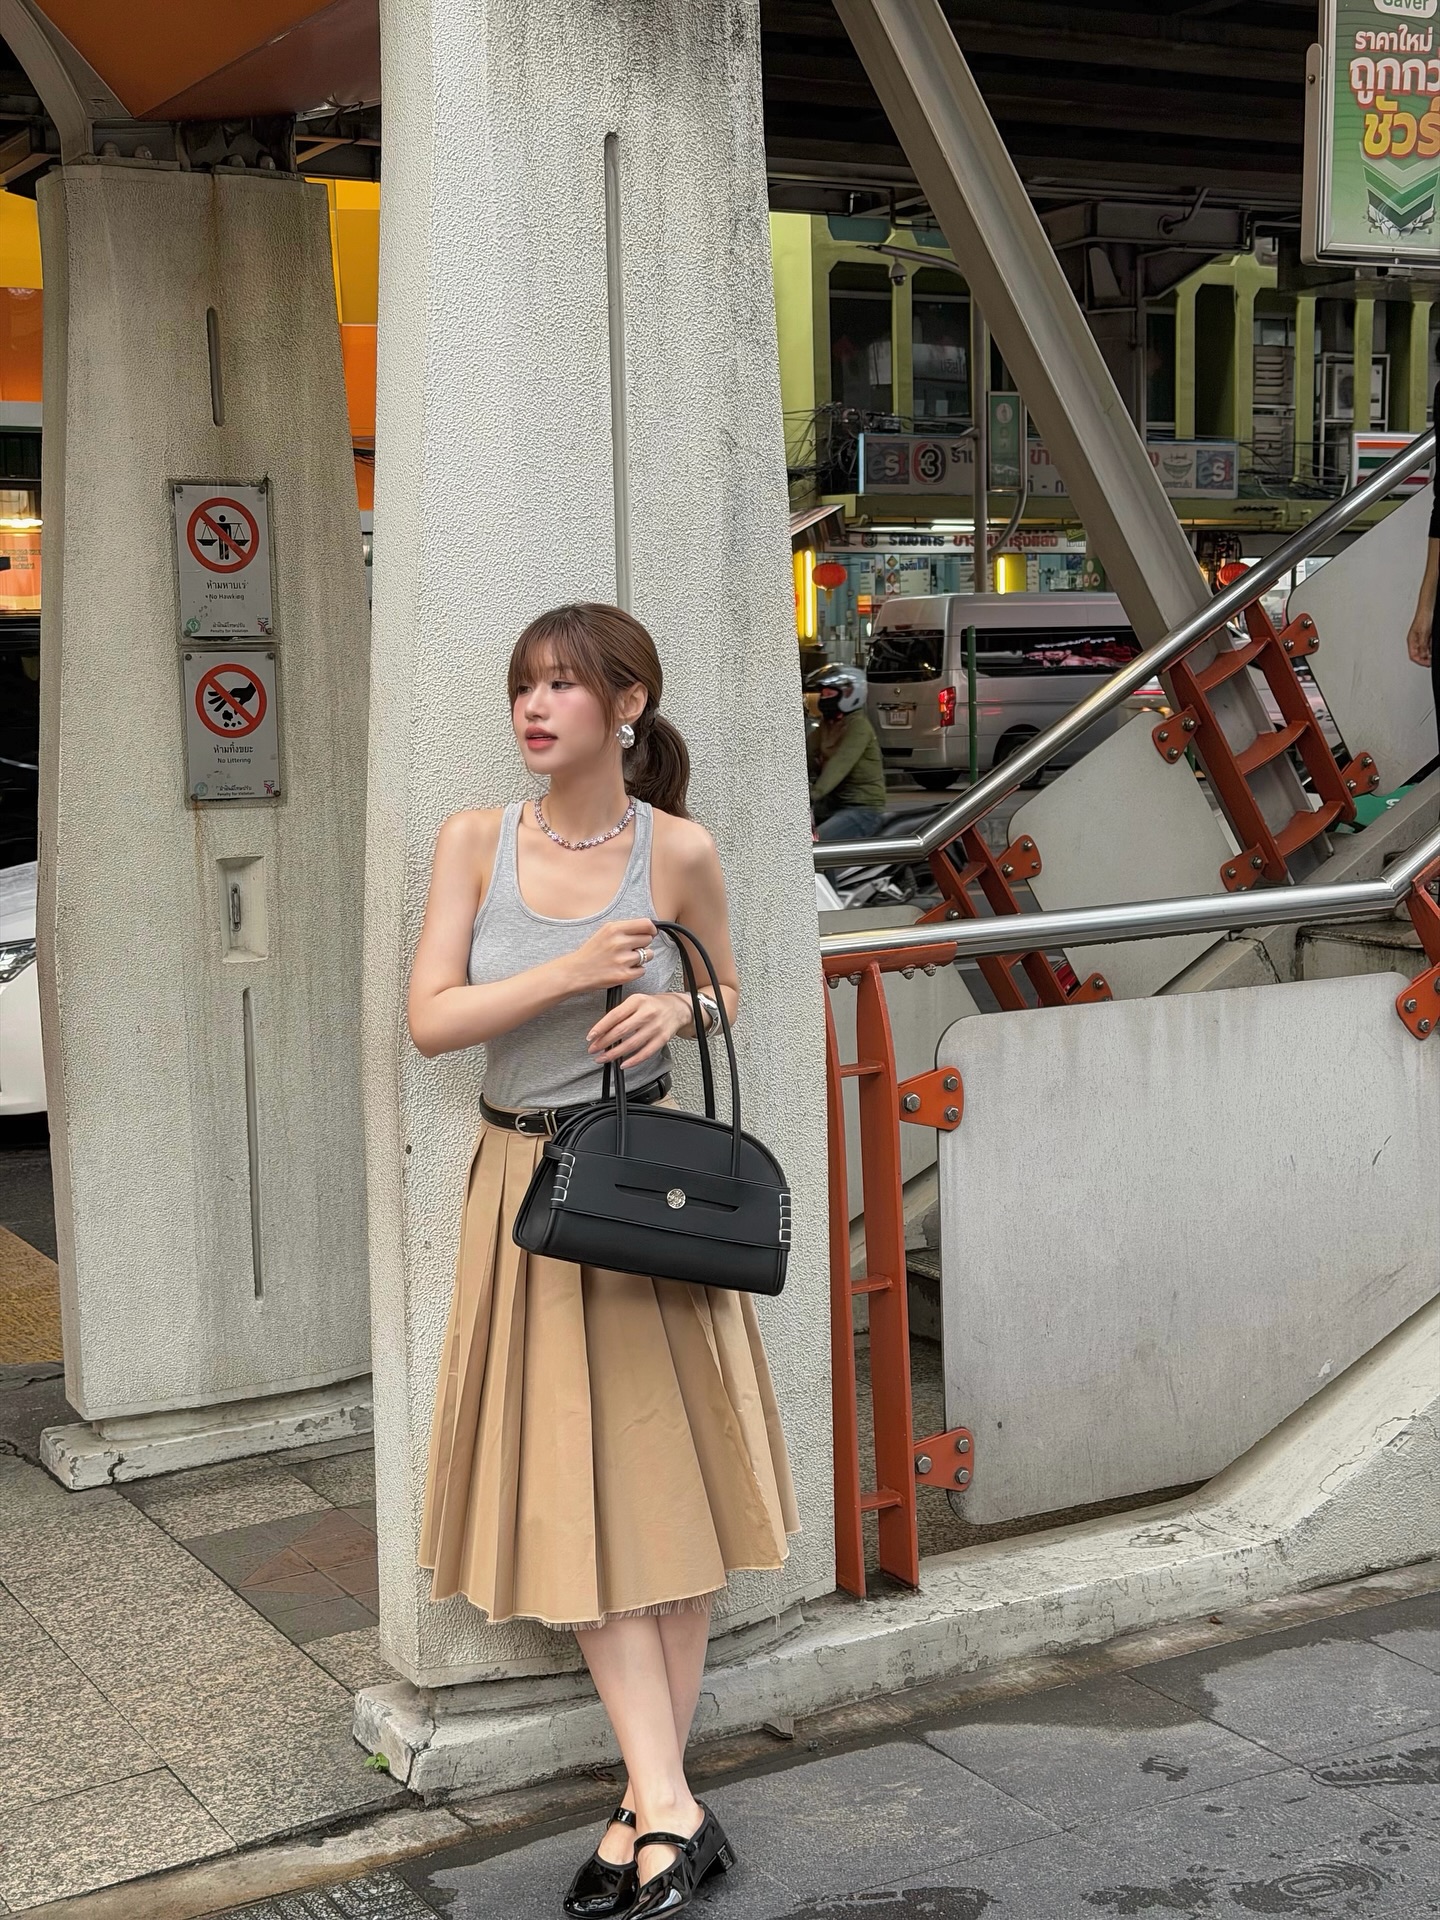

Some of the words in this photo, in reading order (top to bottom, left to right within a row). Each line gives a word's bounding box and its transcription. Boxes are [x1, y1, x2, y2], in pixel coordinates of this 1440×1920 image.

[1355, 24, 1433, 52] ราคาใหม่
[206, 580, 247, 590] ห้ามหาบเร่
[213, 741, 254, 754] ห้ามทิ้งขยะ
[227, 757, 252, 765] Littering
